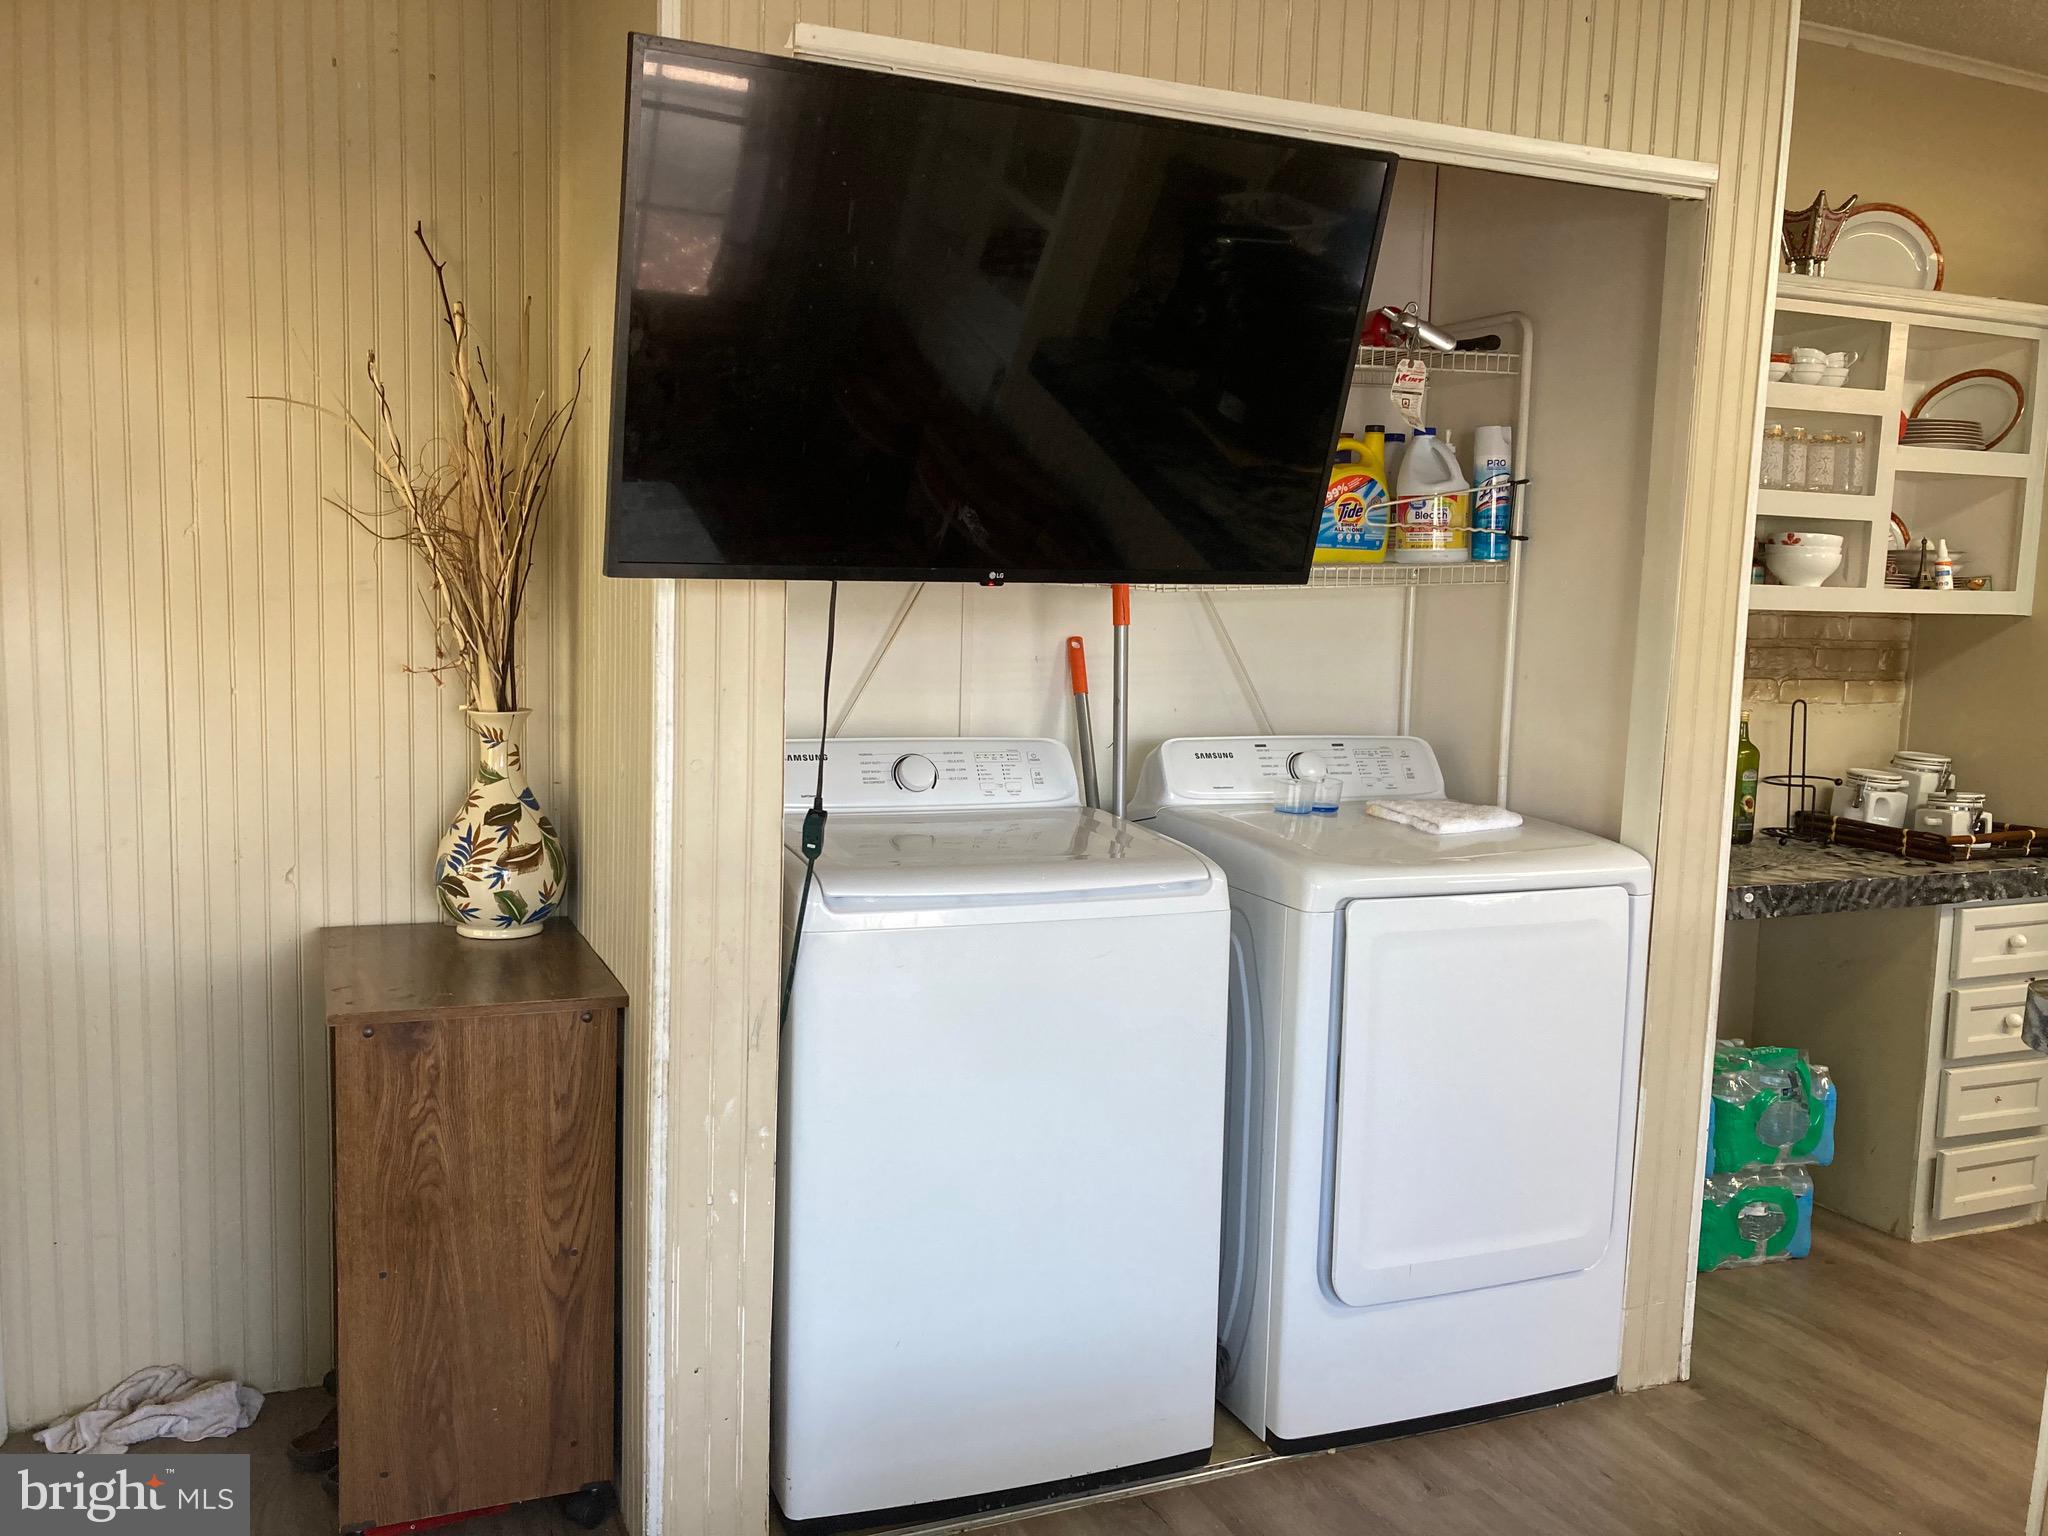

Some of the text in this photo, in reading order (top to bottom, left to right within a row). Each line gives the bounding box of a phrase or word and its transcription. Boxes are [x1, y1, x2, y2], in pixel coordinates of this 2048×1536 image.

[1486, 459, 1506, 467] PRO
[1326, 482, 1348, 501] 99%
[1338, 502, 1363, 522] Tide
[1194, 752, 1234, 760] SAMSUNG
